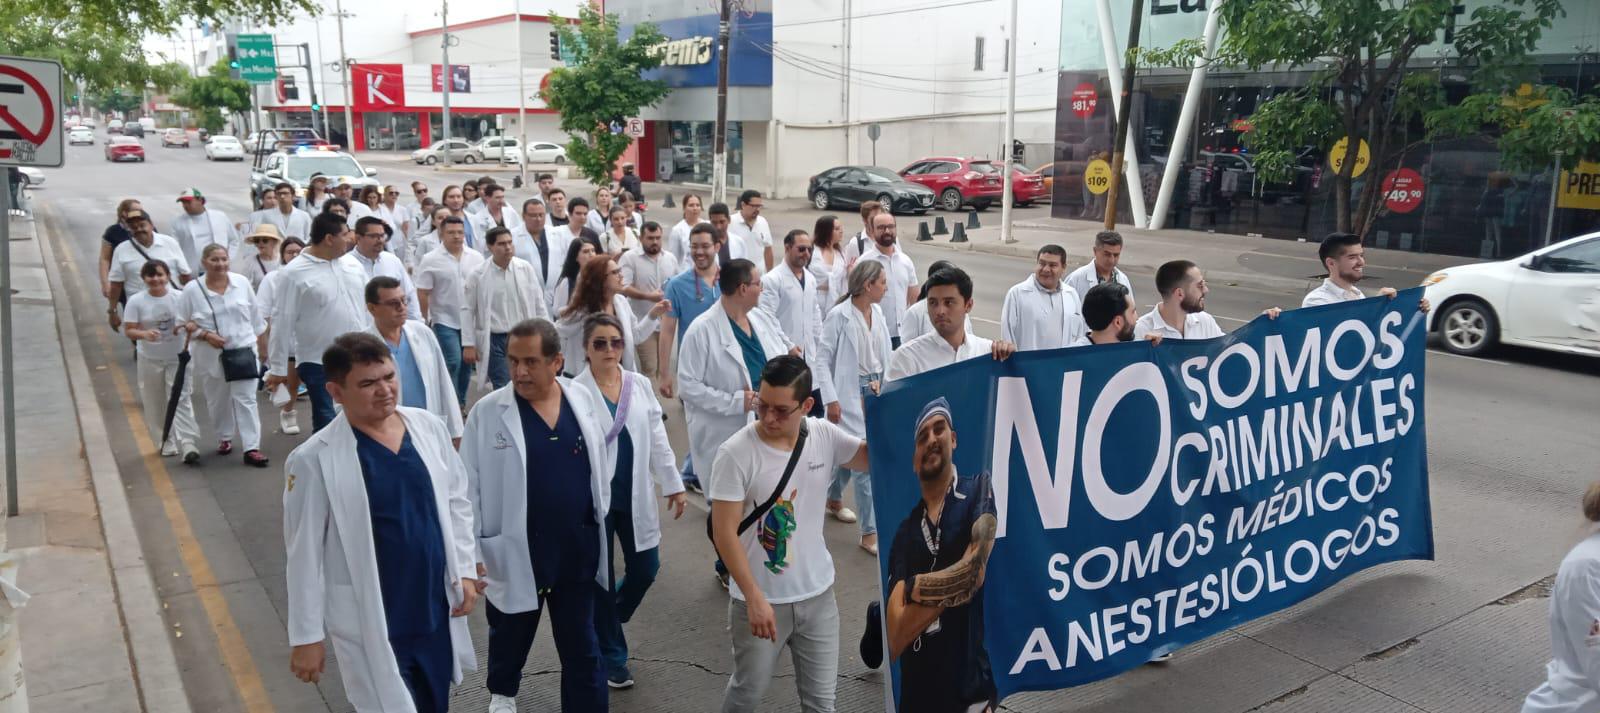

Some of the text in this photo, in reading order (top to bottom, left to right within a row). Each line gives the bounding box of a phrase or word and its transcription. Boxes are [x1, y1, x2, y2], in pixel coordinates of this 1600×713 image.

[367, 72, 395, 105] K
[1087, 176, 1108, 187] $109
[1181, 311, 1405, 421] SOMOS
[990, 362, 1172, 538] NO
[1170, 373, 1415, 506] CRIMINALES
[1009, 508, 1399, 674] ANESTESIÓLOGOS
[1048, 457, 1393, 601] SOMOS MÉDICOS
